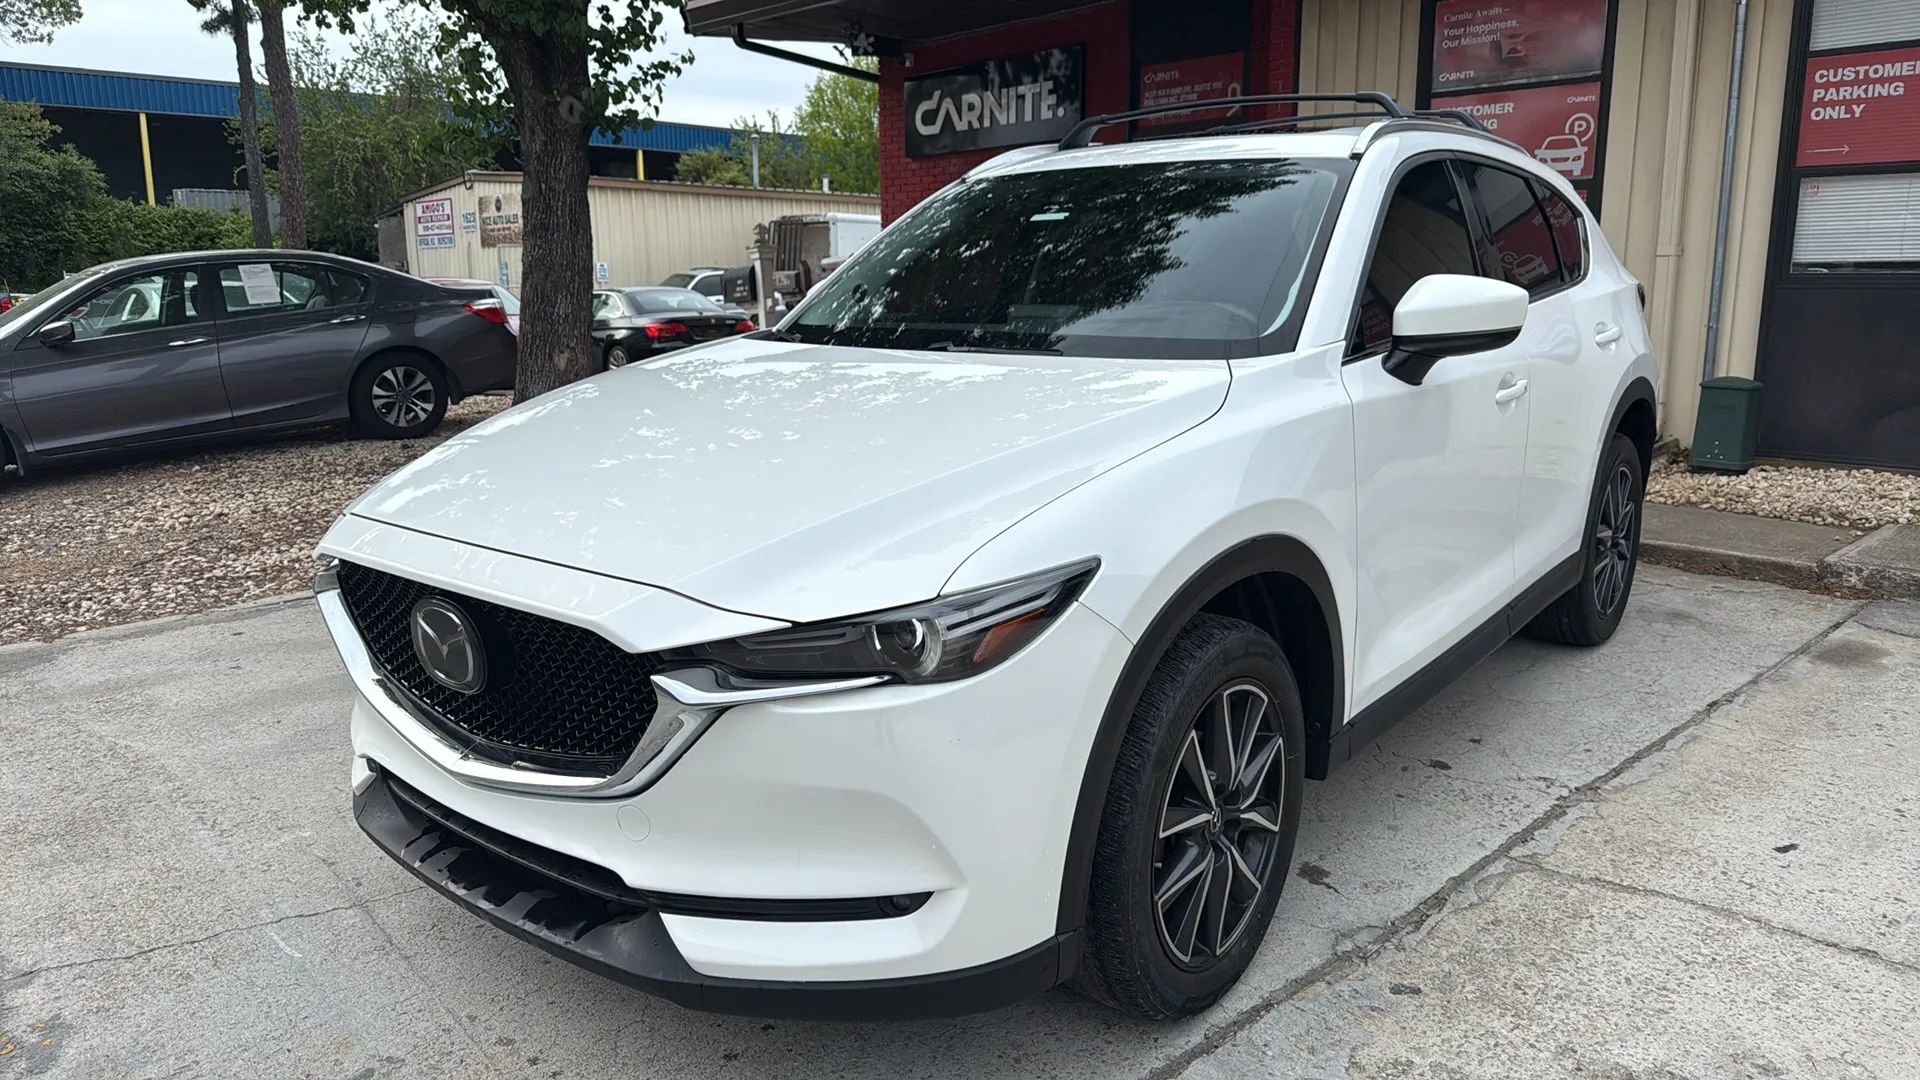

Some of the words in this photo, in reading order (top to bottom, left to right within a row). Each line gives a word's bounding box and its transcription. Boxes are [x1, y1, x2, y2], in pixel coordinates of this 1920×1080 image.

[1444, 11, 1473, 22] Carnite
[1442, 40, 1460, 48] Our
[1460, 32, 1500, 46] Mission!
[1443, 28, 1465, 37] Your
[1812, 81, 1905, 103] PARKING
[1810, 103, 1866, 121] ONLY
